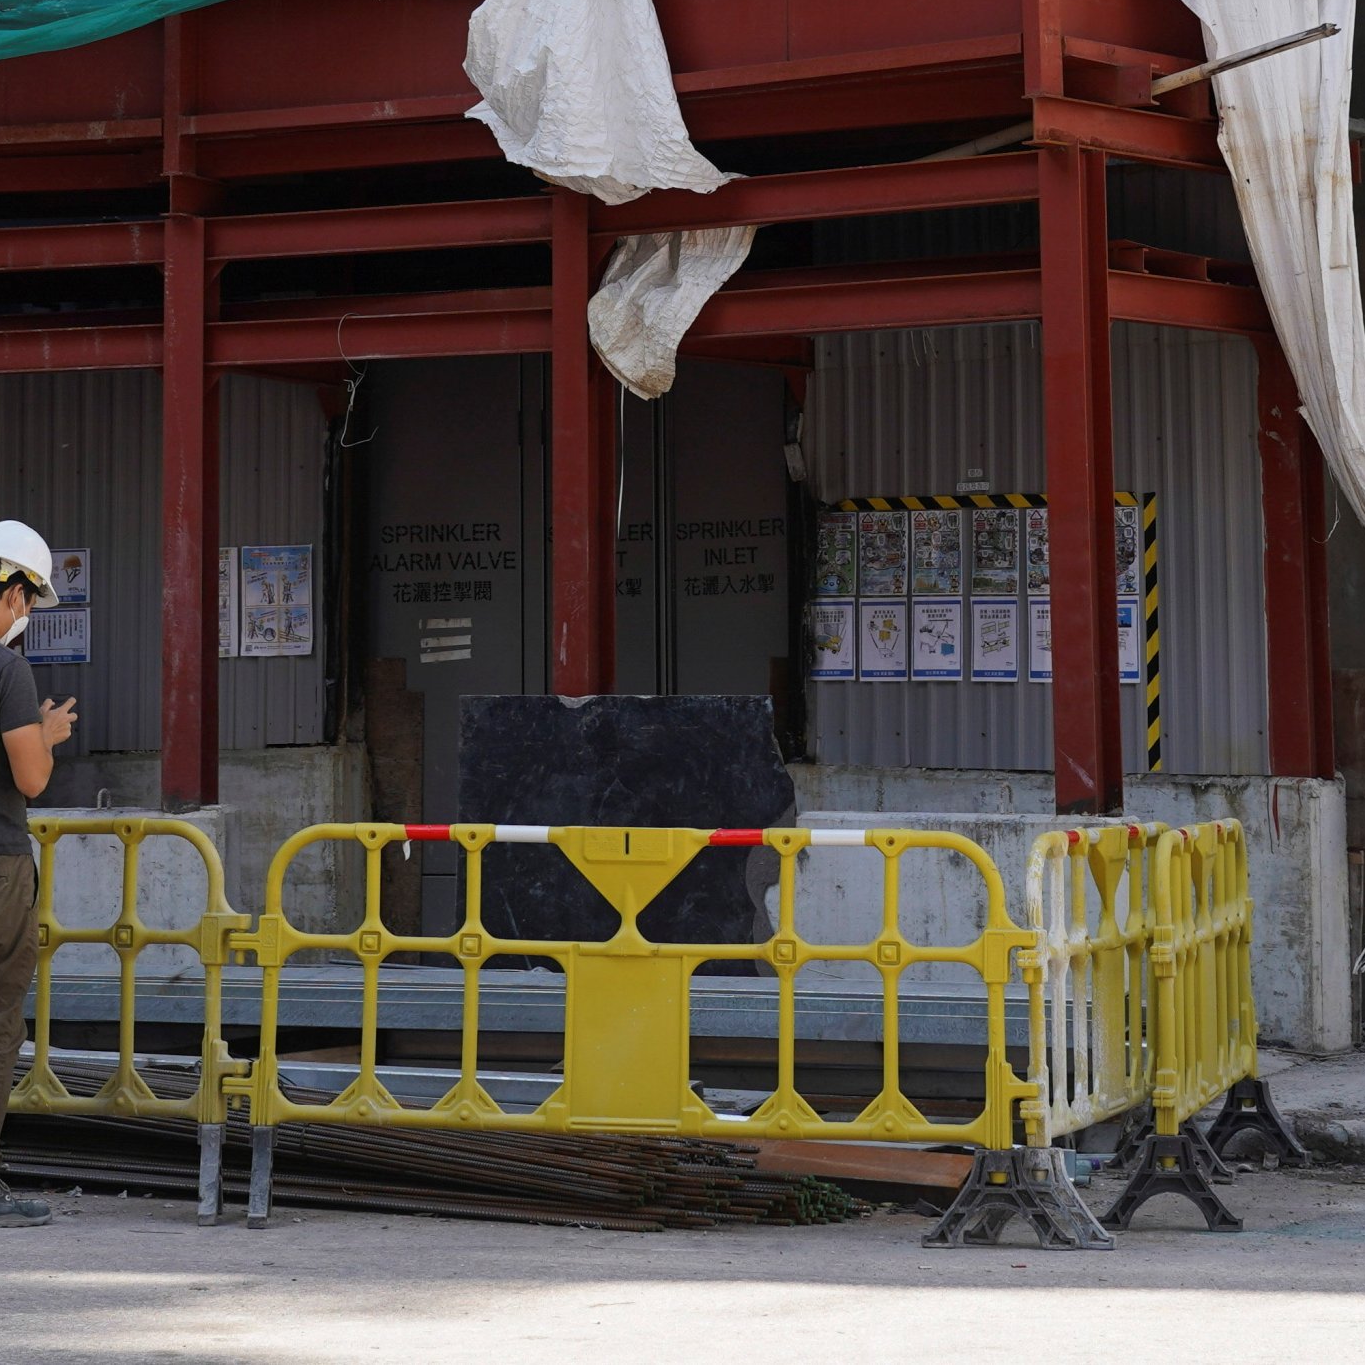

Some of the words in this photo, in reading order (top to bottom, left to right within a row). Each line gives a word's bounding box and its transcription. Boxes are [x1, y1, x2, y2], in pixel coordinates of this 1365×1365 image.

[381, 522, 501, 545] SPRINKLER
[675, 517, 786, 541] SPRINKLER
[369, 552, 441, 573] ALARM
[447, 550, 516, 571] VALVE
[703, 546, 758, 567] INLET
[392, 580, 493, 604] 花灑控掣閥
[683, 572, 776, 597] 花灑入水掣
